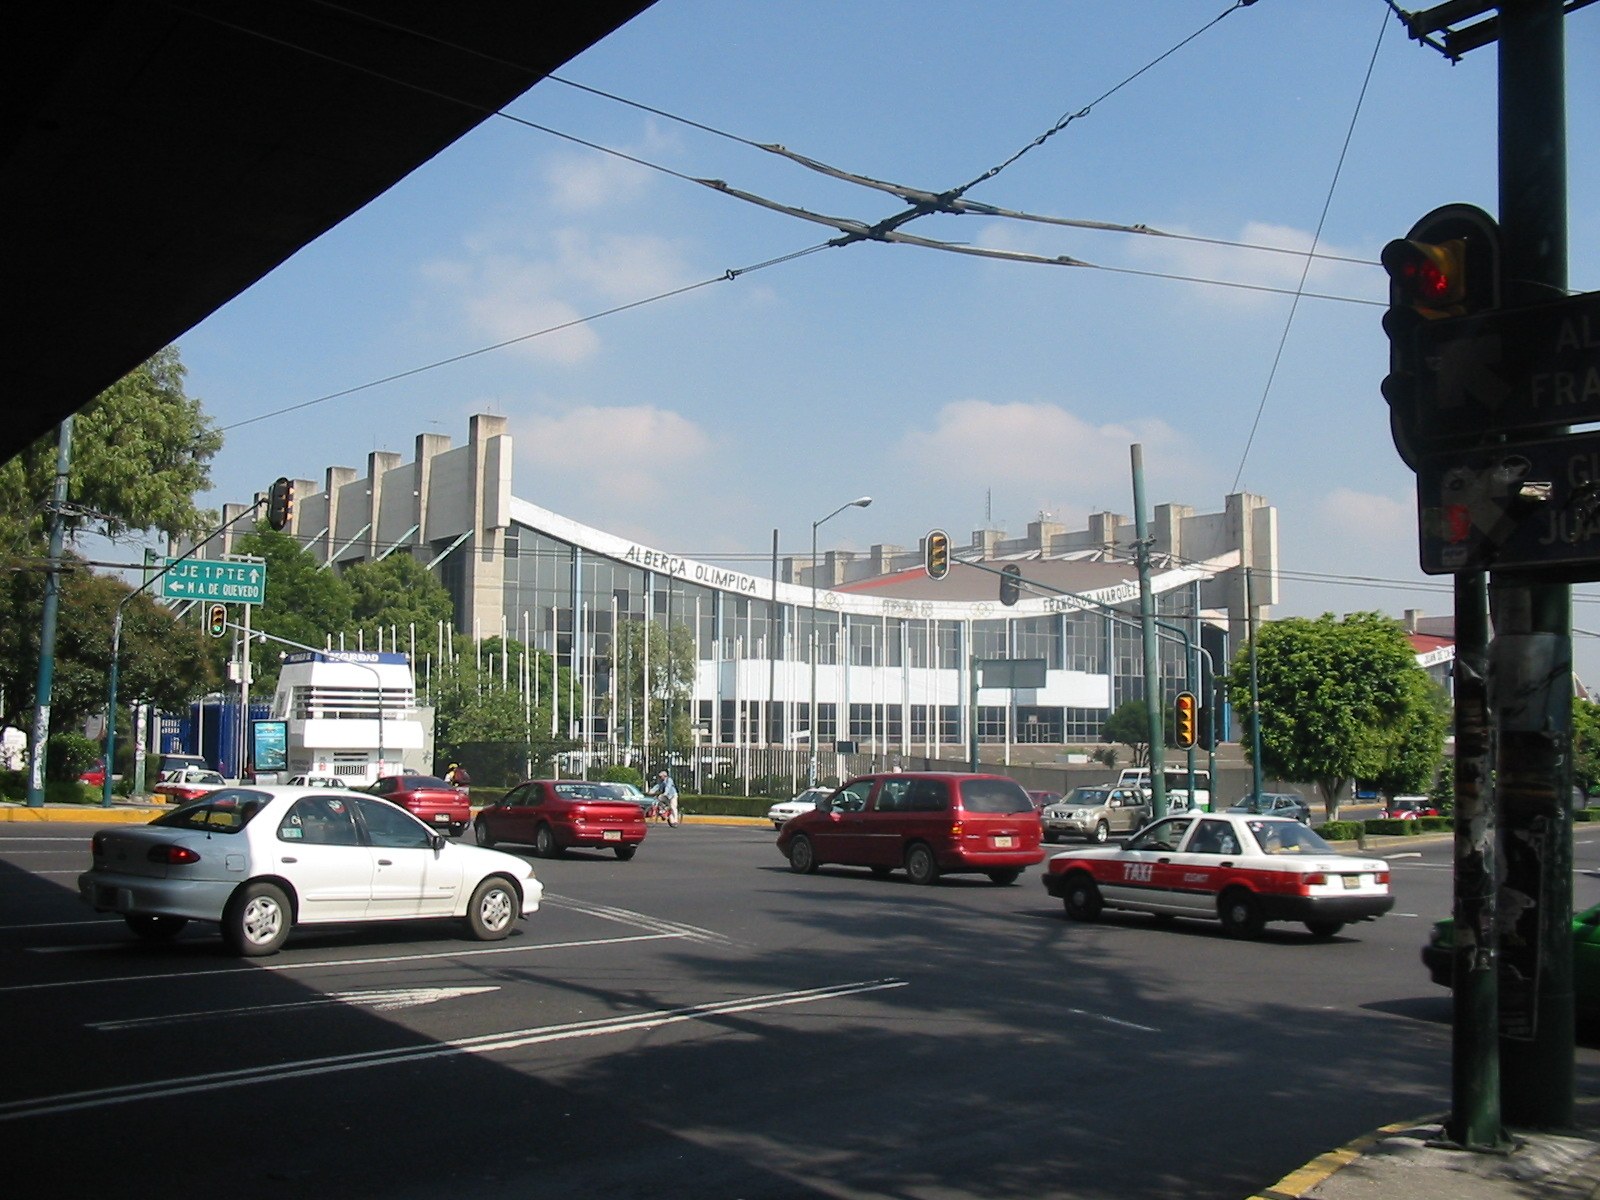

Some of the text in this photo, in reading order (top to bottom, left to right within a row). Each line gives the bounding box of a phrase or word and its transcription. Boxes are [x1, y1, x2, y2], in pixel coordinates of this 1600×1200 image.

[168, 564, 245, 581] EJE 1 PTE
[625, 545, 757, 593] ALBERCA OLIMPICA
[187, 581, 259, 598] M A DE QUEVEDO
[1123, 862, 1154, 882] TAXI
